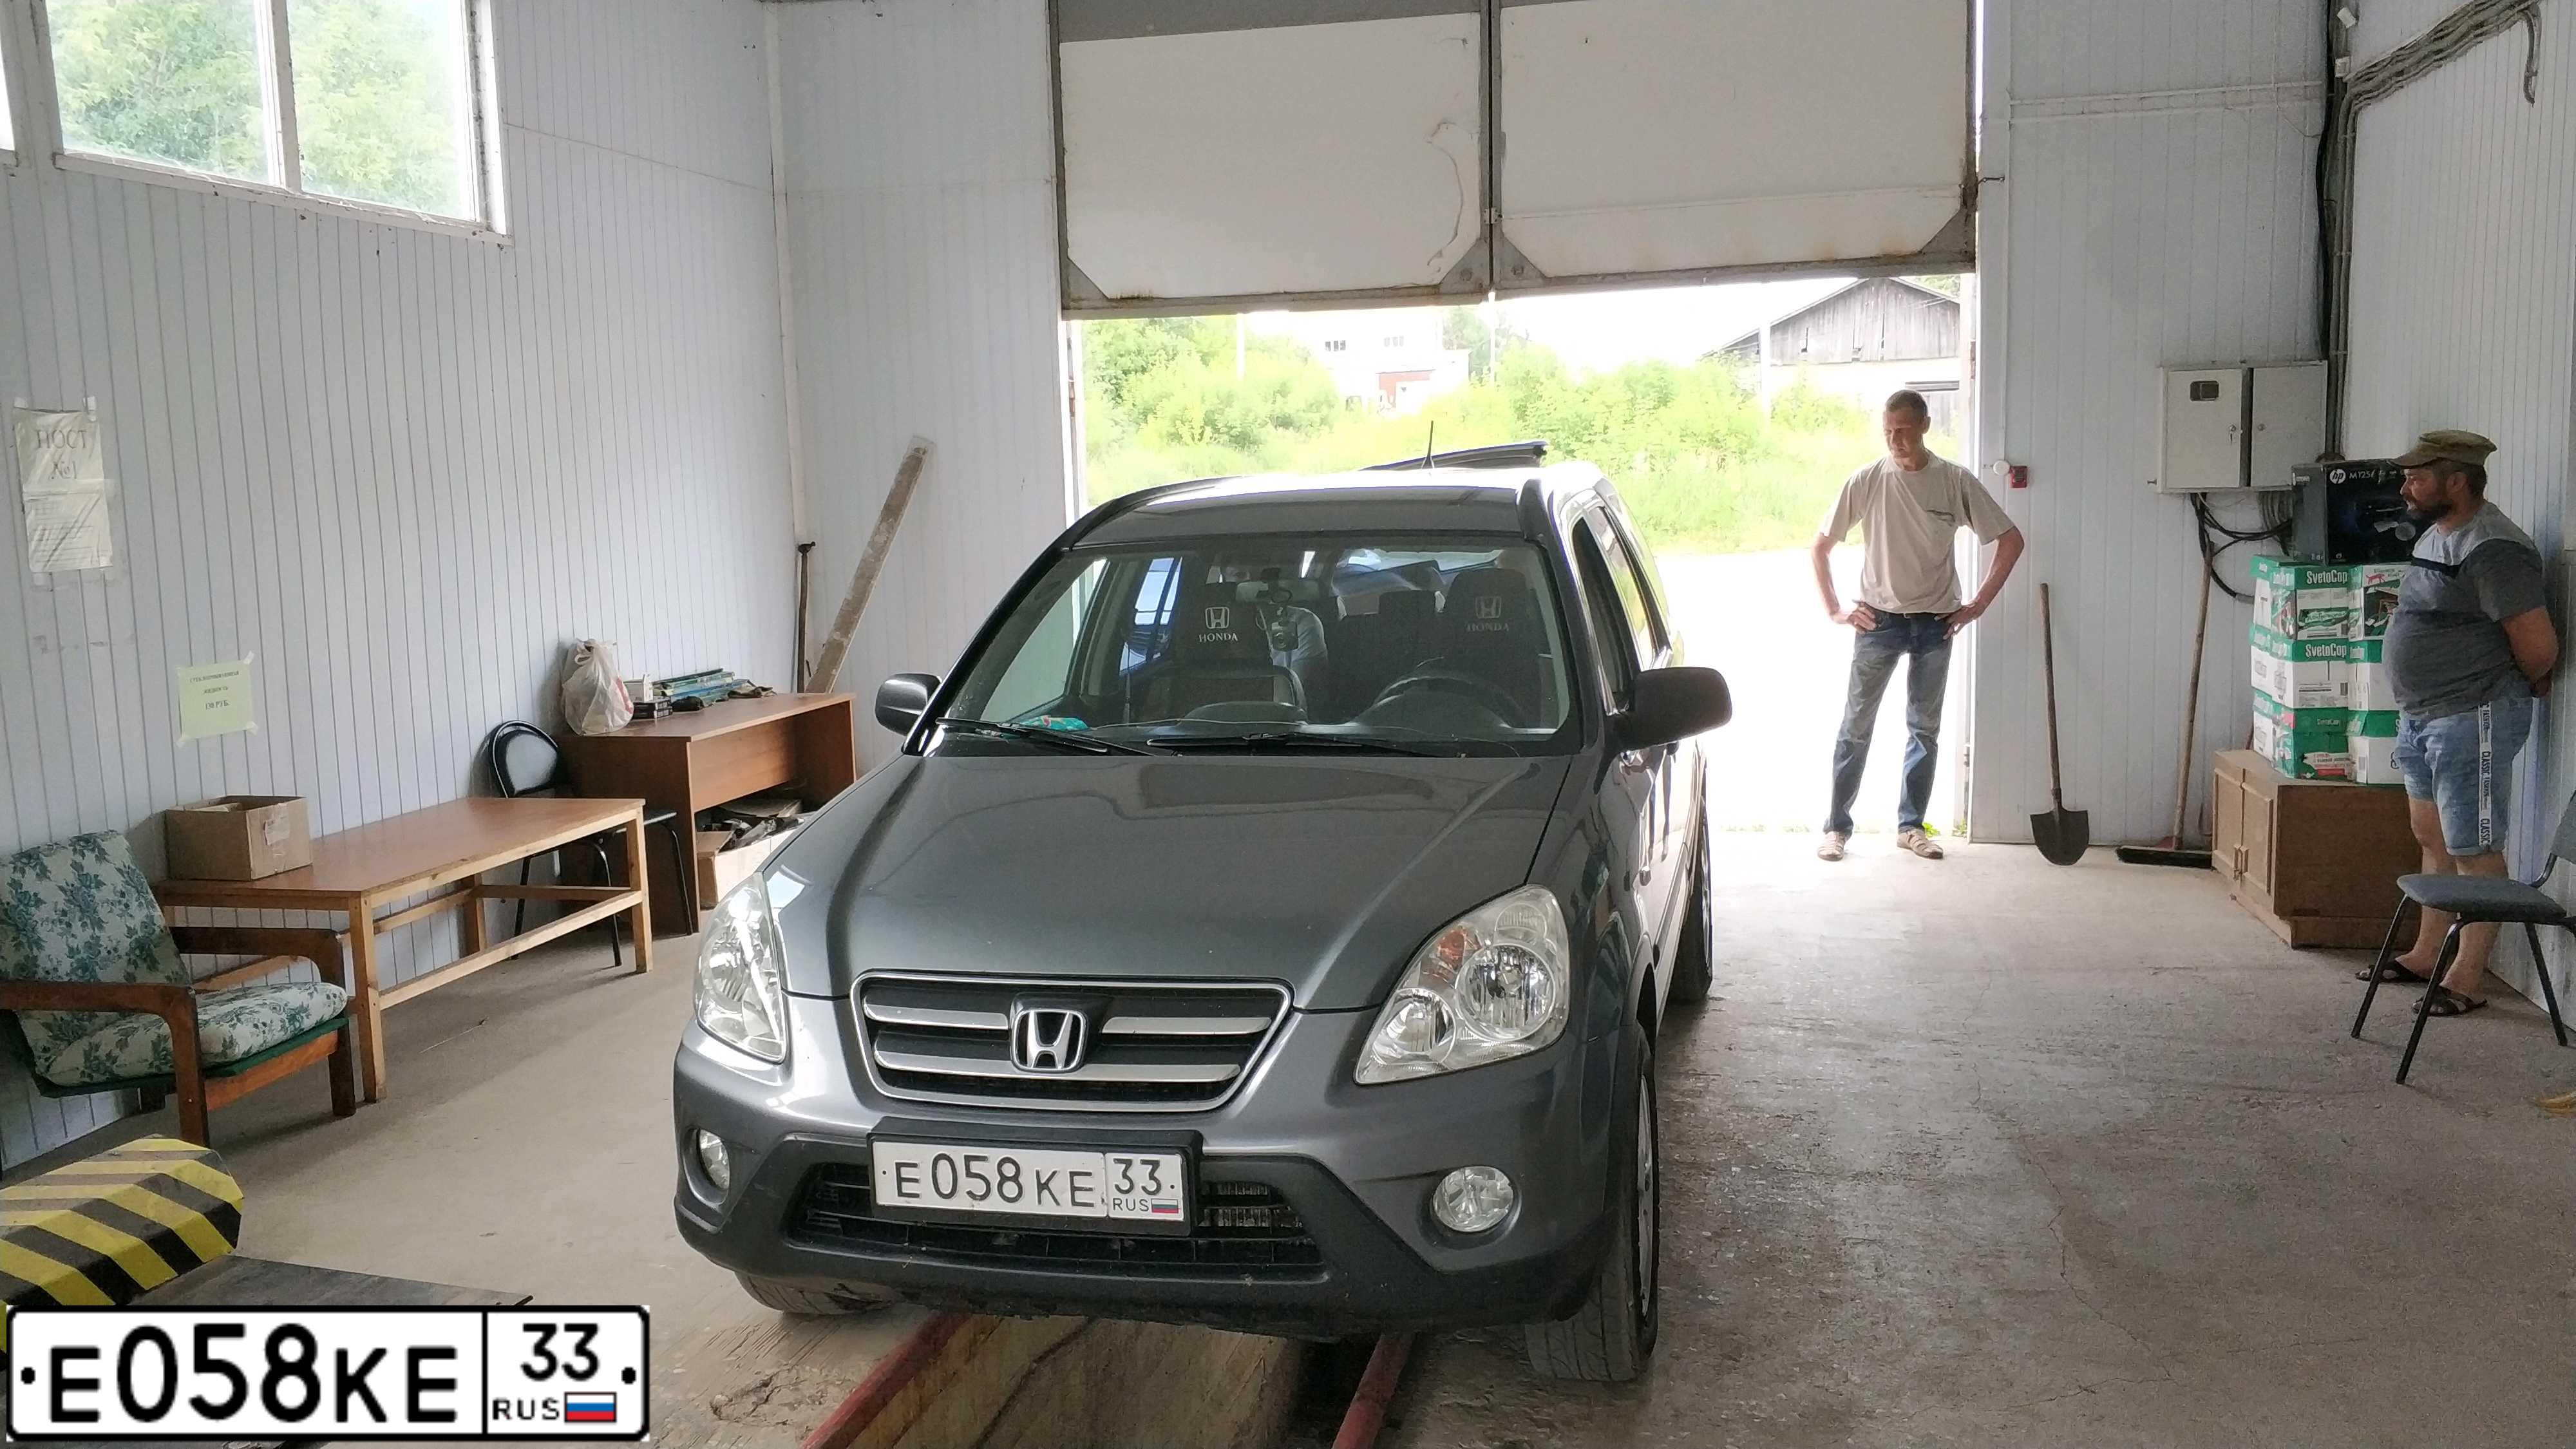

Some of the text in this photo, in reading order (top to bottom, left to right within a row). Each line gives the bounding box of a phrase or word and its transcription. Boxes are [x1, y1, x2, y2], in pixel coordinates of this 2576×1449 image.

[2330, 469, 2346, 484] hp
[2306, 569, 2348, 584] SvetoCop
[1464, 622, 1509, 632] HONDA
[1198, 632, 1238, 643] HONDA
[2305, 643, 2347, 658] SvetoCop
[2481, 751, 2490, 775] CLASSIC
[2480, 818, 2490, 844] CLASSIC
[1113, 1158, 1160, 1195] 33
[1112, 1198, 1149, 1211] RUS
